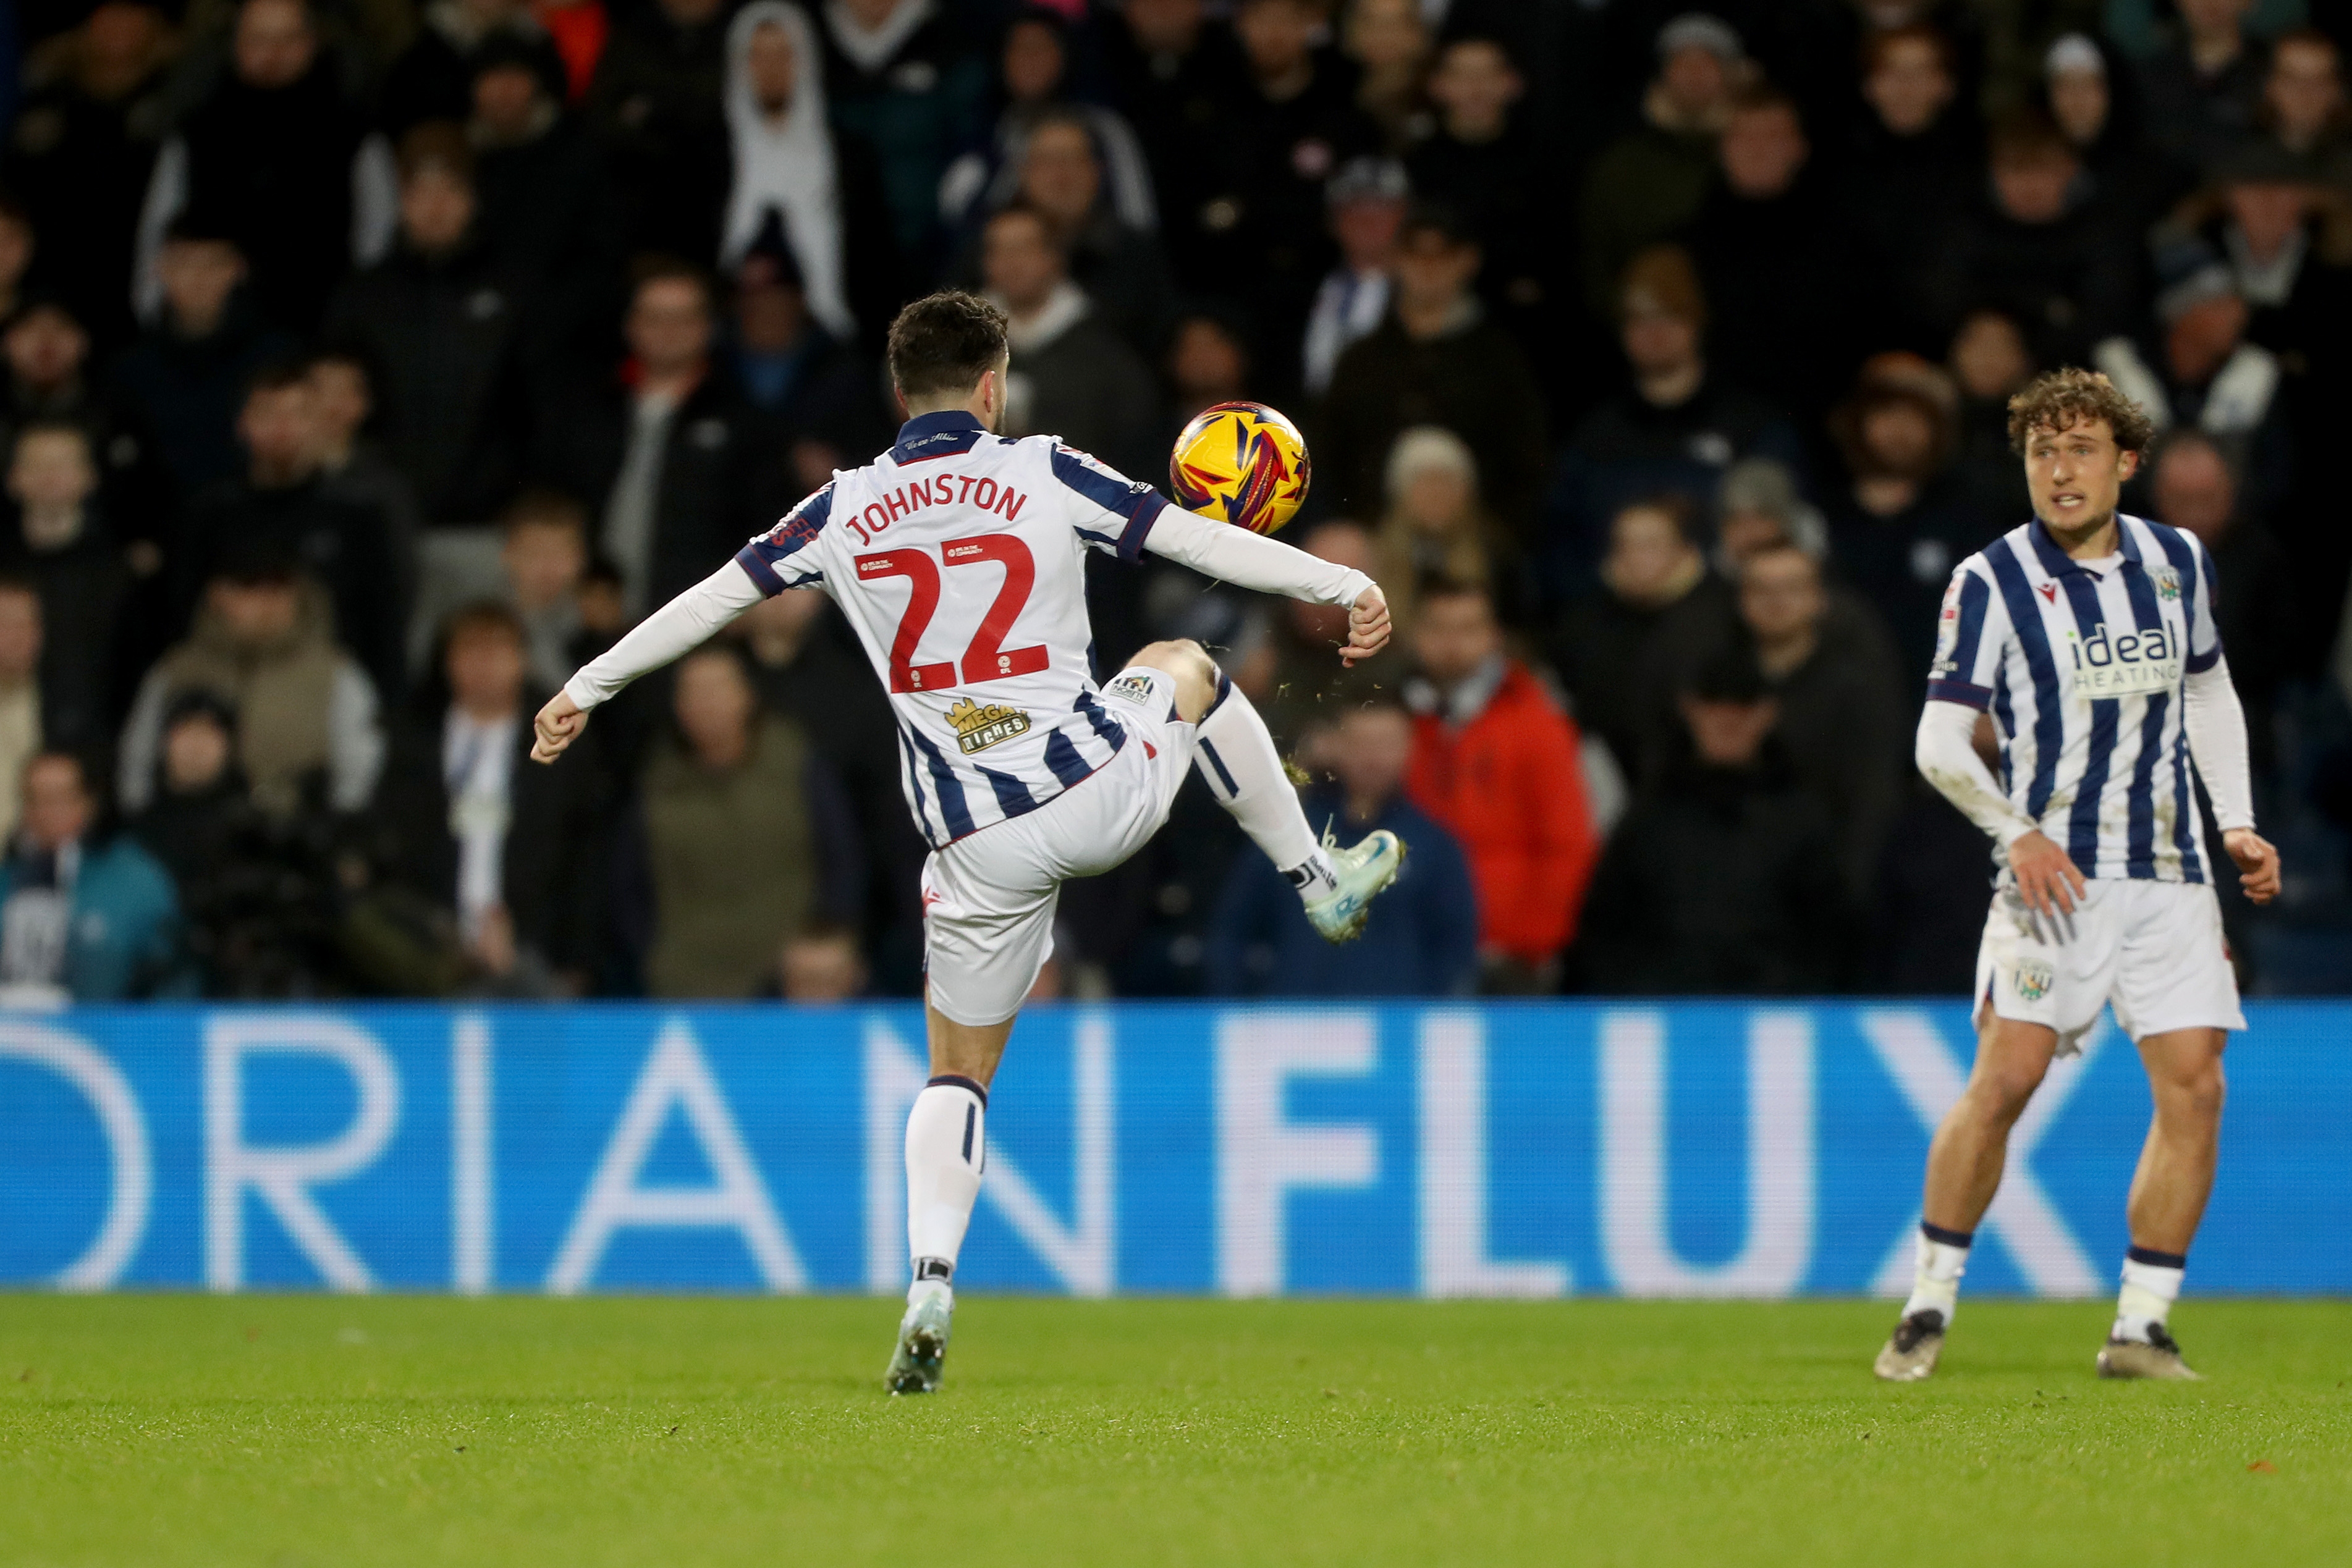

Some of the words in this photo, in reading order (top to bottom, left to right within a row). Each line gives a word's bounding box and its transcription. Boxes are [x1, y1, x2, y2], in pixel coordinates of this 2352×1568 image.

[845, 473, 1028, 547] JOHNSTON
[853, 533, 1050, 694] 22
[2066, 619, 2178, 670] ideal
[957, 704, 1017, 733] MEGA
[962, 717, 1025, 750] RICHES
[1215, 1011, 2111, 1296] FLUX
